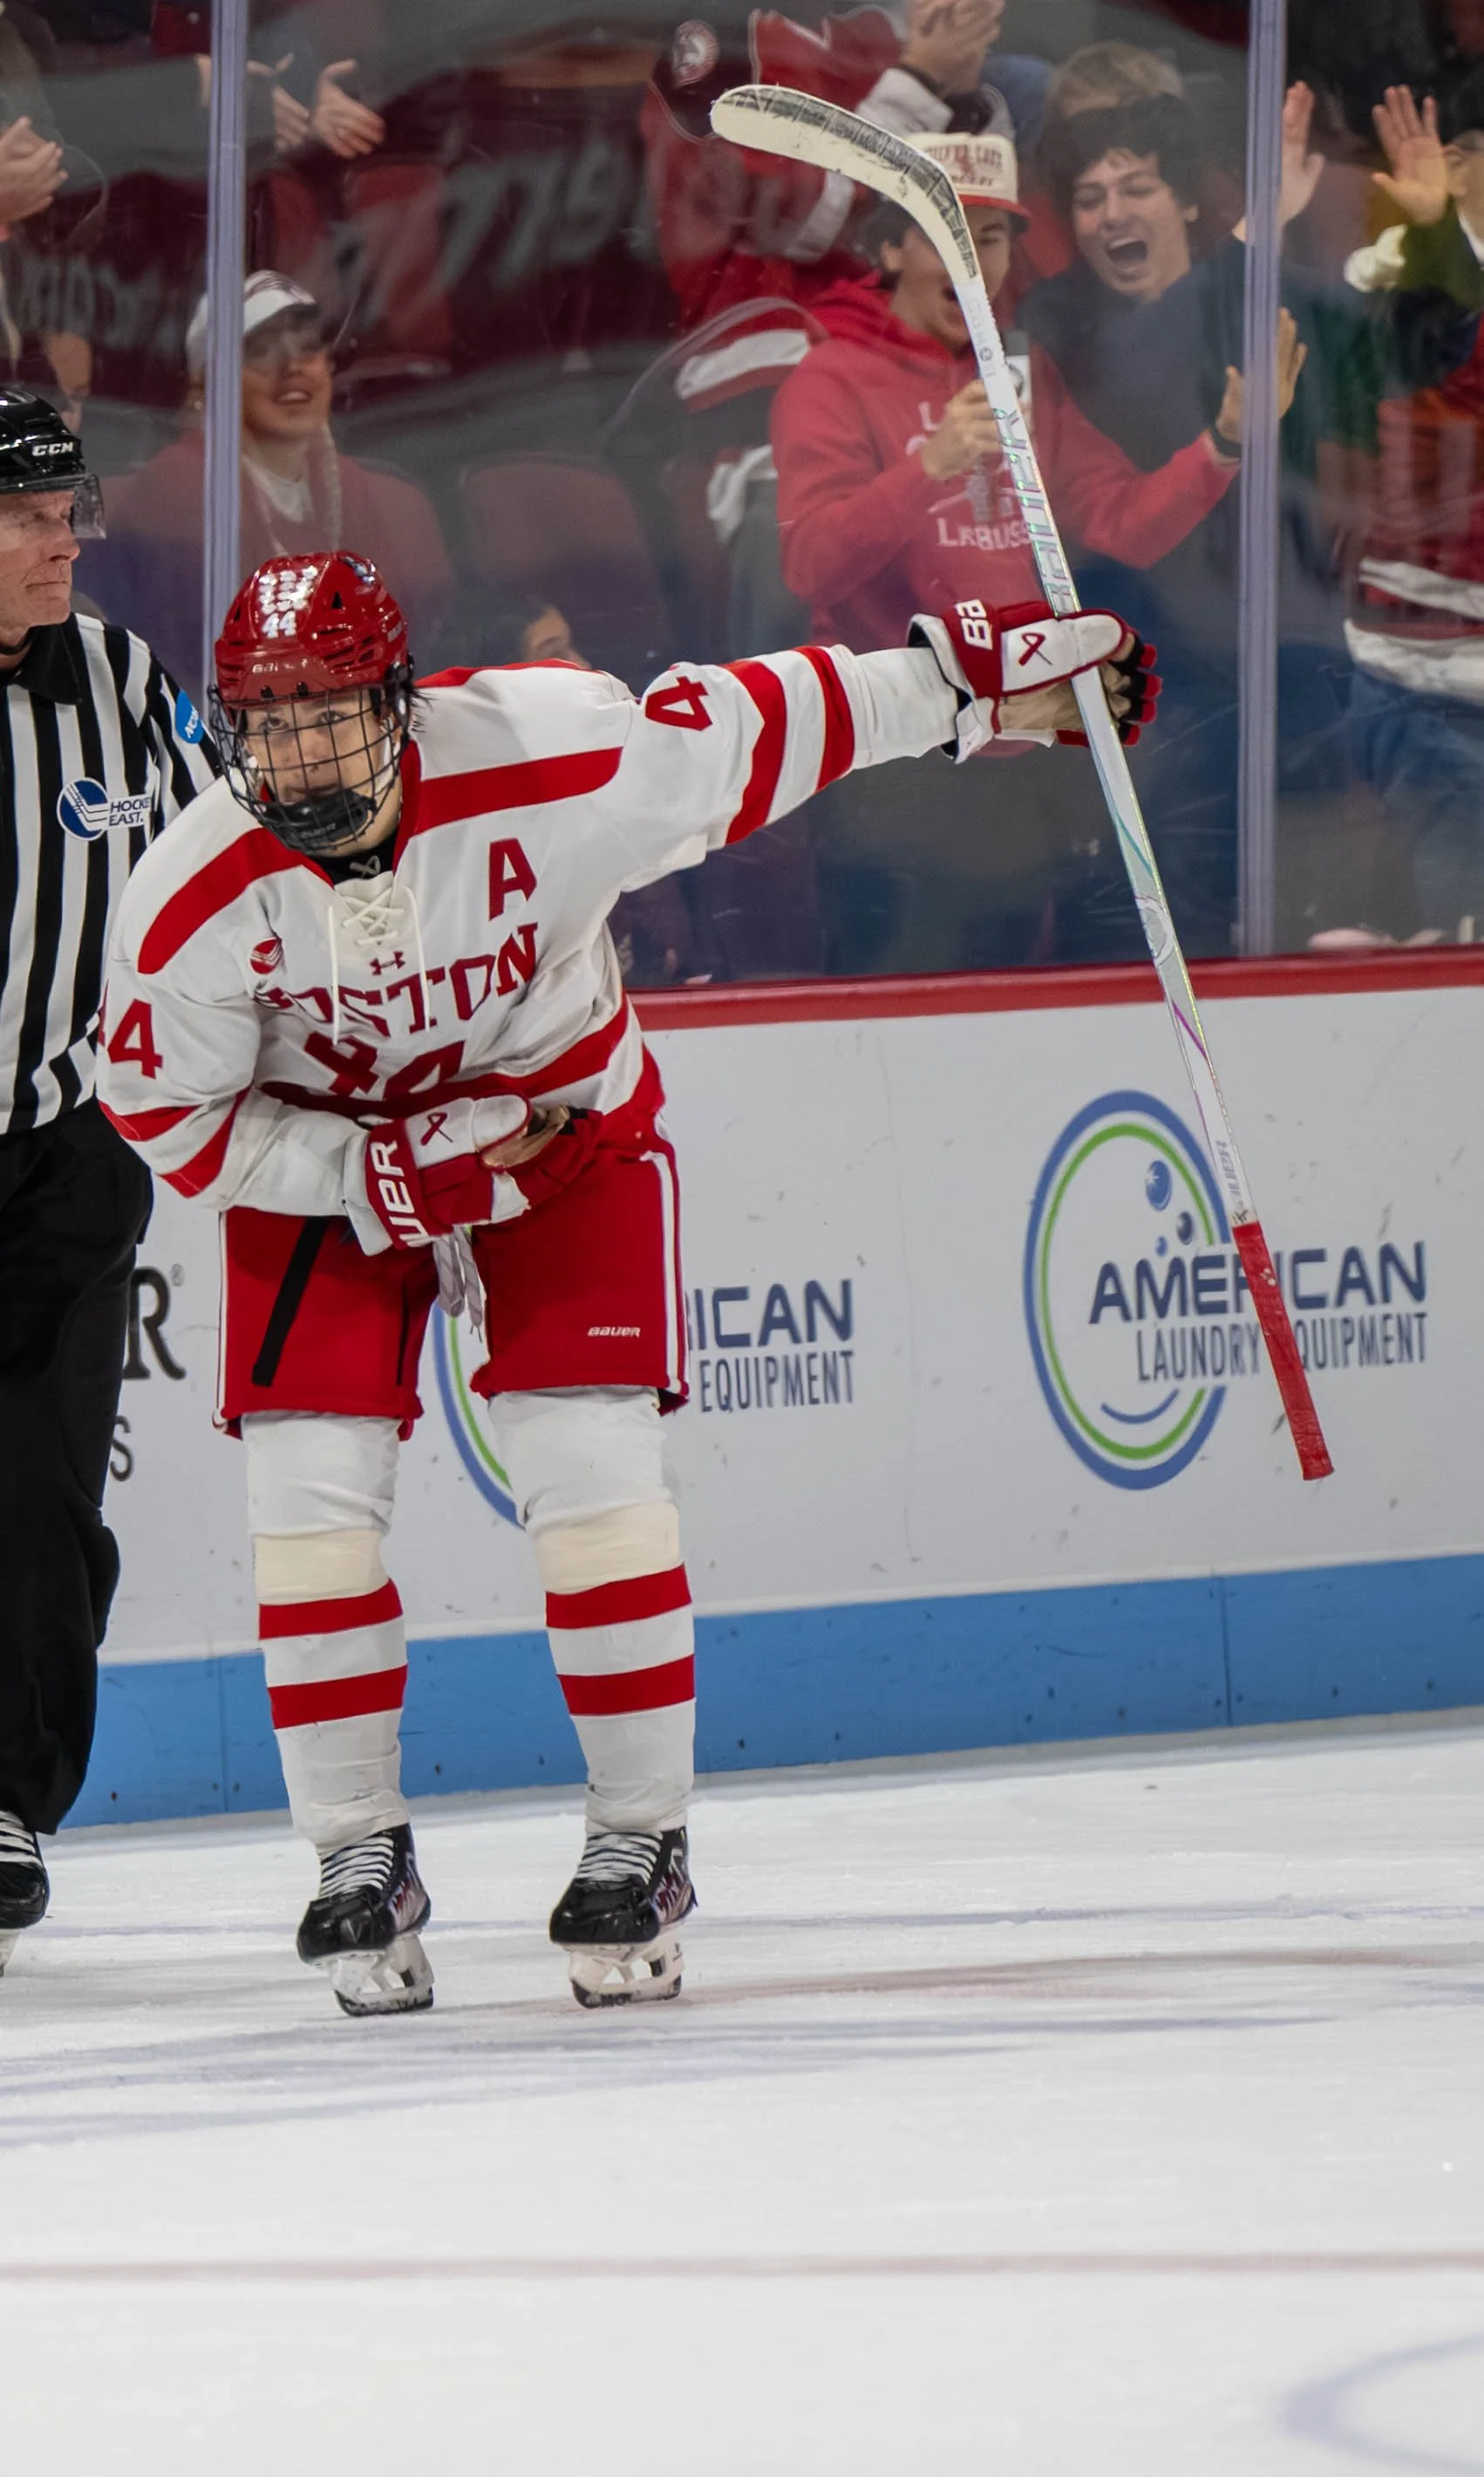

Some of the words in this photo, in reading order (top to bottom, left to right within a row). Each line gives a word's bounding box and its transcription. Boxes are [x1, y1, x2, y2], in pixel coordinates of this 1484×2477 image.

[31, 441, 74, 457] CCM
[262, 611, 296, 638] 44
[488, 836, 538, 922] A
[97, 978, 163, 1080] 4
[370, 1140, 437, 1248] UER
[684, 1278, 854, 1352] ICAN
[1136, 1321, 1261, 1383] LAUNDRY
[1293, 1312, 1428, 1372] QUIPMENT
[700, 1349, 854, 1413] EQUIPMENT
